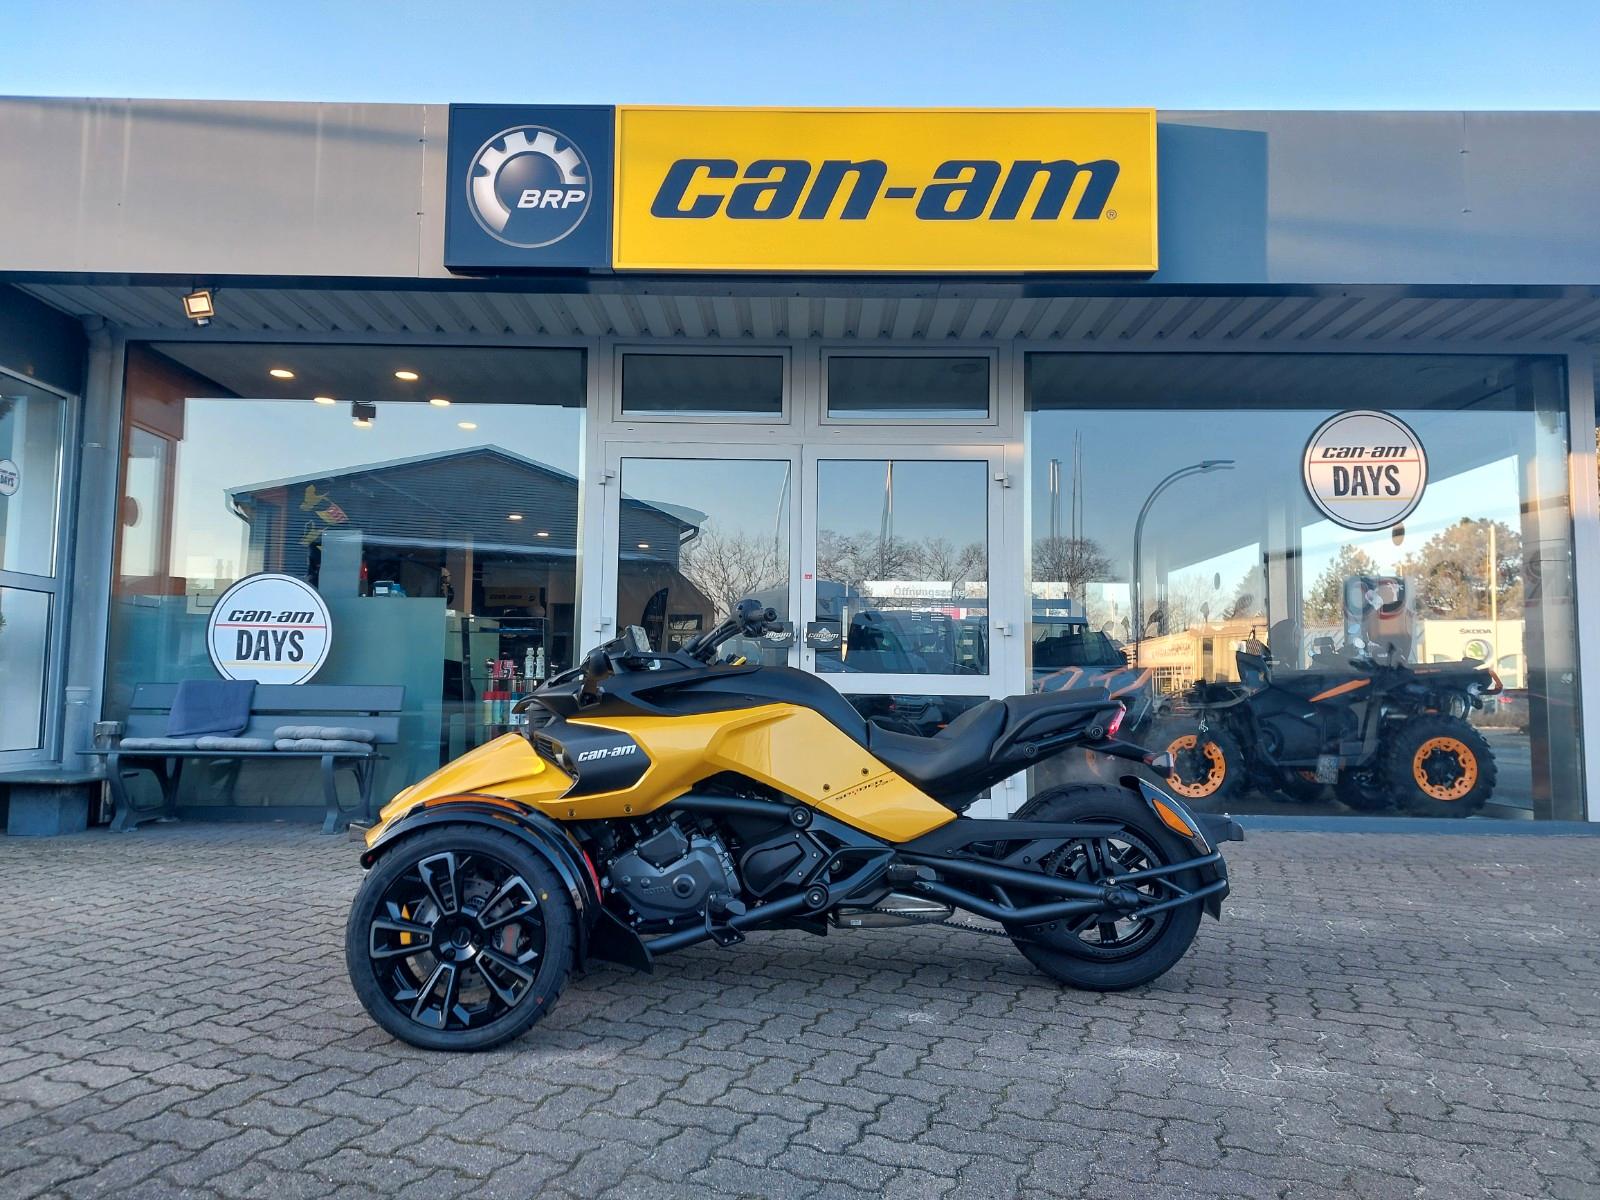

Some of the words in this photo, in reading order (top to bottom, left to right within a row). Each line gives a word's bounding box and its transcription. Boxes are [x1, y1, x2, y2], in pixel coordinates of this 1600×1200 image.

[650, 159, 1121, 220] can-am
[517, 190, 585, 208] BRP
[1322, 446, 1407, 459] can-am
[1333, 465, 1400, 496] DAYS
[228, 610, 314, 623] can-am
[236, 630, 304, 662] DAYS
[578, 745, 636, 762] can-am
